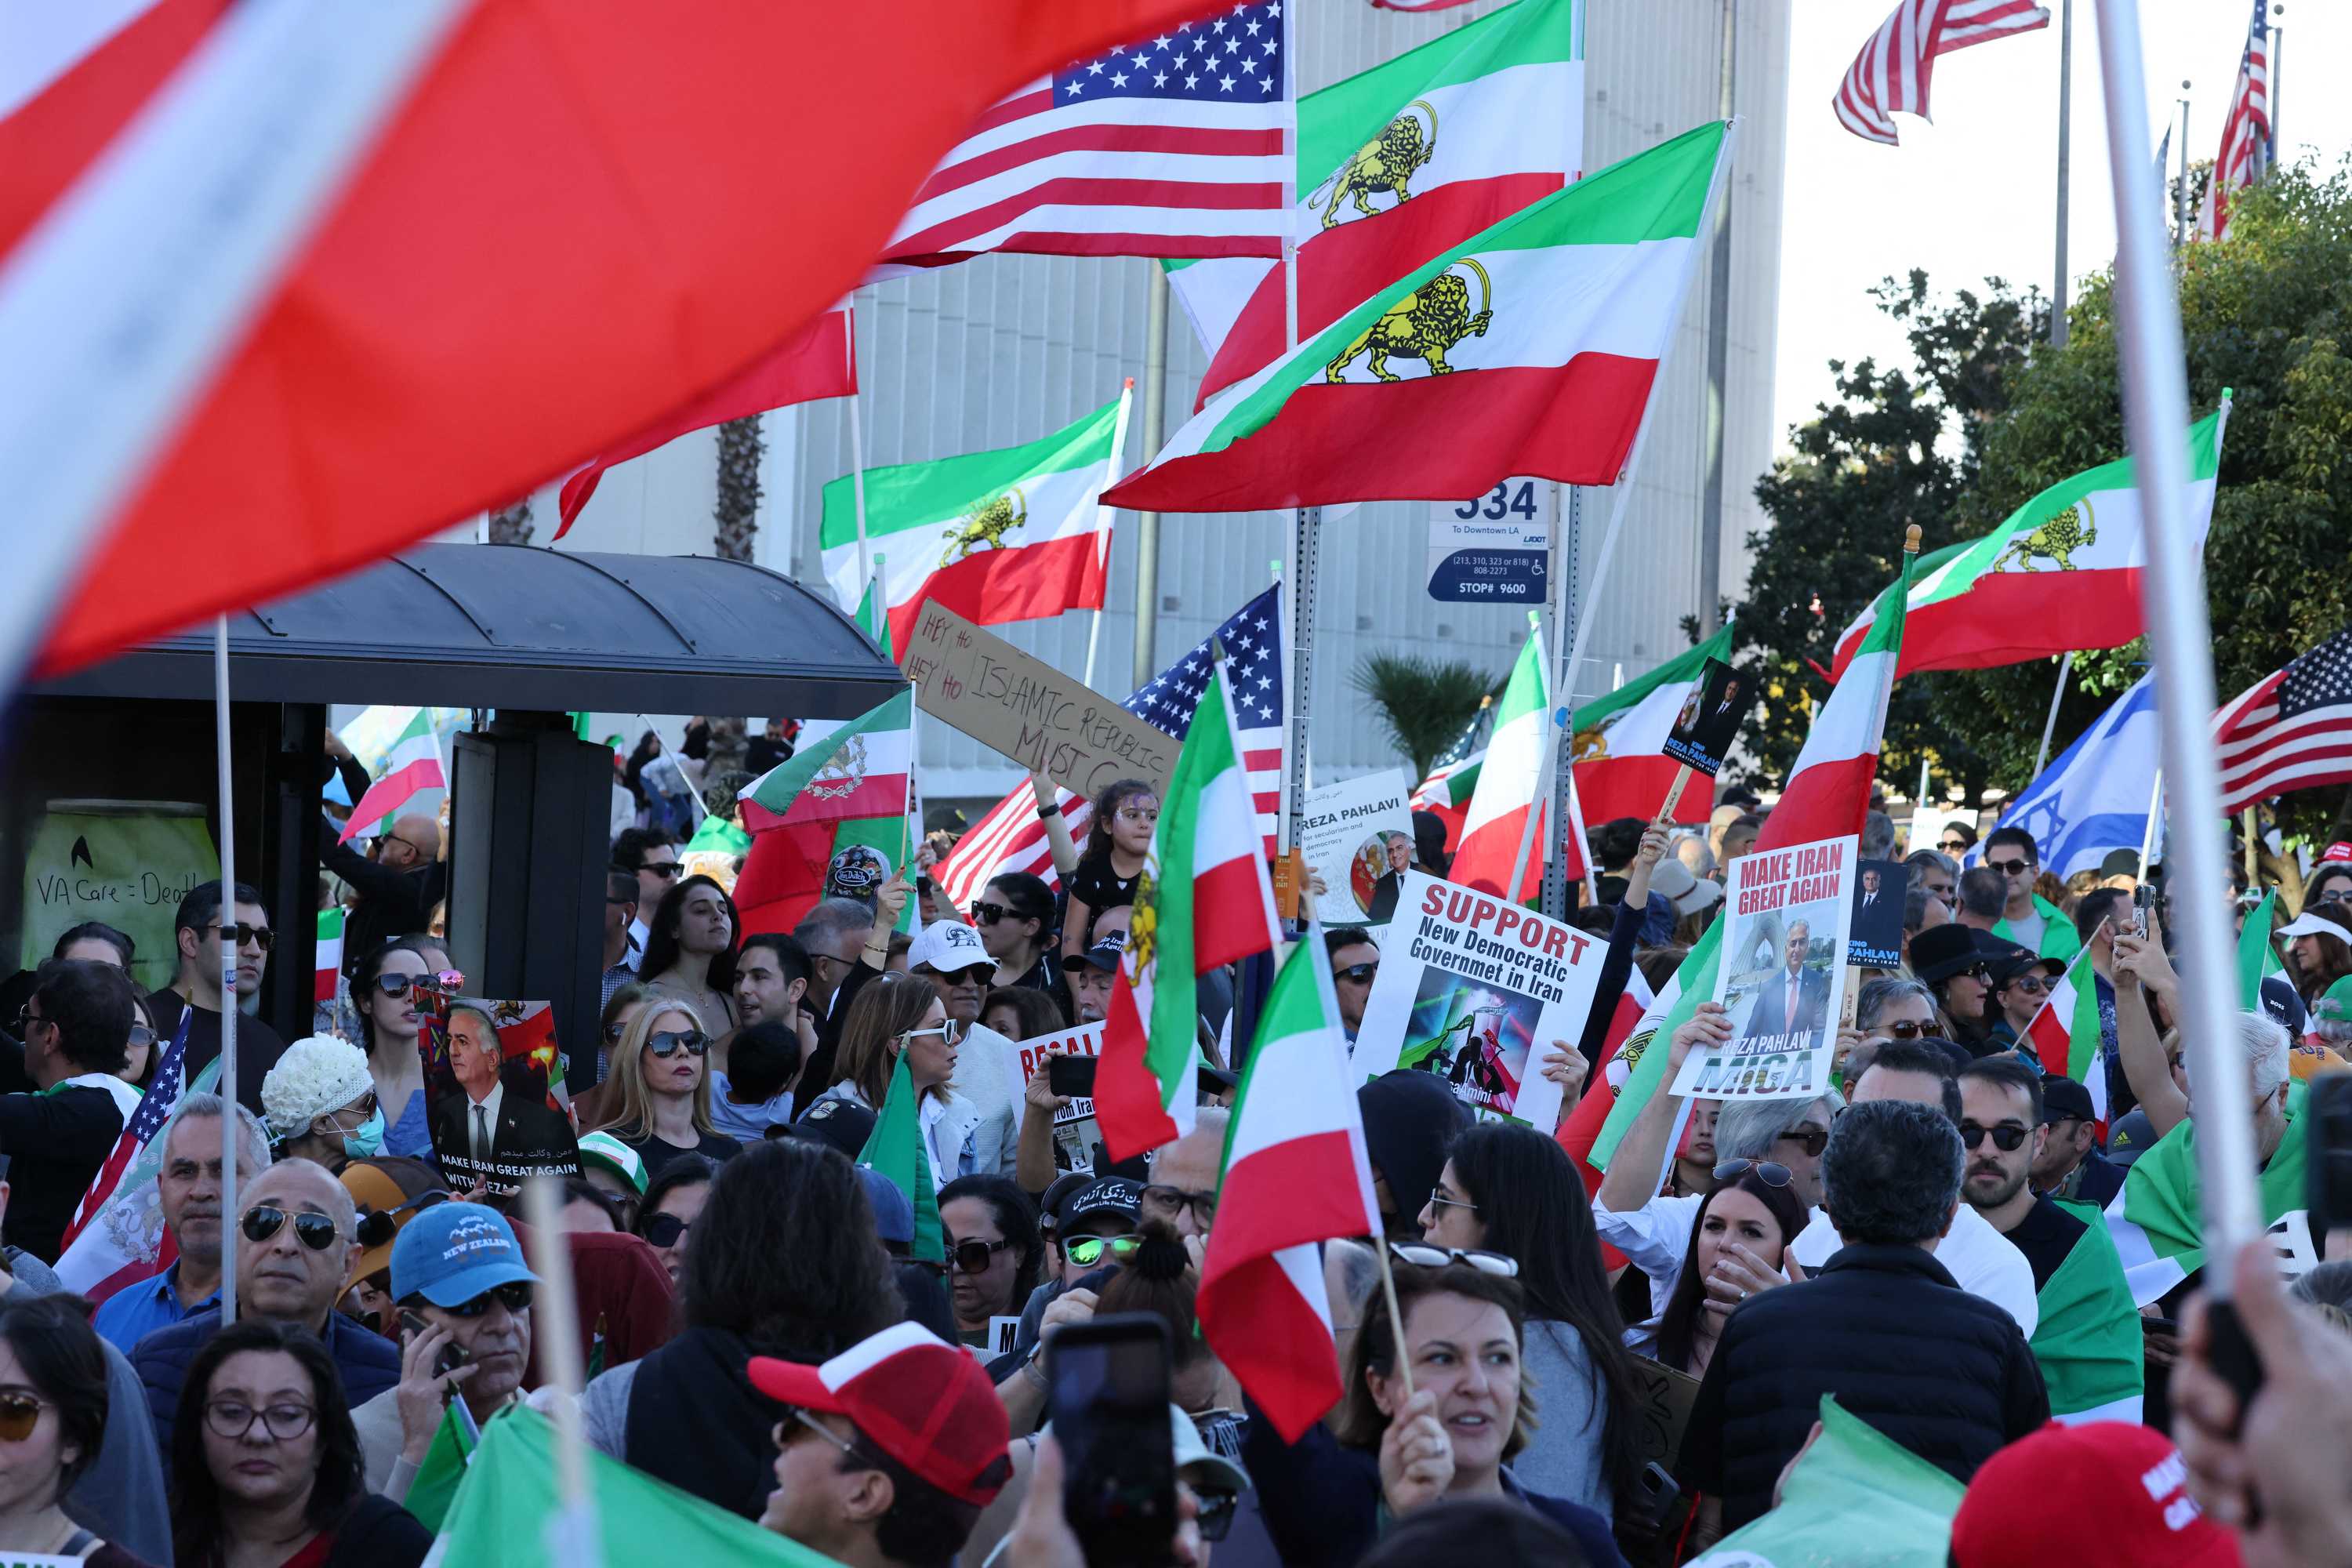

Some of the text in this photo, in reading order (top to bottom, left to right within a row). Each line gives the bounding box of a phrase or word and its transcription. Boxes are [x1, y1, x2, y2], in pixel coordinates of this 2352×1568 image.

[1464, 525, 1506, 534] Downtown
[1474, 566, 1507, 575] 808-2273
[1513, 557, 1529, 566] 818)
[1459, 583, 1526, 593] STOP# 9600
[922, 612, 973, 649] HEY HO
[942, 670, 963, 701] HO
[971, 655, 1164, 773] ISLAMIC REPUBLIC
[1014, 721, 1090, 778] MUST
[1667, 737, 1720, 770] REZA PAHLAVI
[1301, 797, 1399, 831] REZA PAHLAVI
[1315, 826, 1349, 839] secularism
[1350, 822, 1363, 830] and
[1305, 838, 1342, 851] democracy
[1317, 851, 1330, 859] Iran
[1740, 843, 1843, 890] MAKE IRAN
[38, 875, 71, 905] VA
[76, 878, 119, 903] Care
[1738, 873, 1840, 916] GREAT AGAIN
[1421, 884, 1590, 966] SUPPORT
[1418, 916, 1568, 983] New Democratic
[1848, 948, 1899, 960] PAHLAVI
[1410, 937, 1563, 1004] Governmet in Iran
[2270, 1000, 2285, 1011] BOSS
[1721, 1029, 1812, 1054] REZA PAHLAVI
[1450, 1081, 1493, 1104] saAmini
[1056, 1104, 1075, 1120] rom
[441, 1153, 578, 1177] MAKE IRAN GREAT AGAIN
[445, 1172, 476, 1189] WITH
[486, 1181, 510, 1196] EZA
[443, 1239, 511, 1261] NEW ZEALAND
